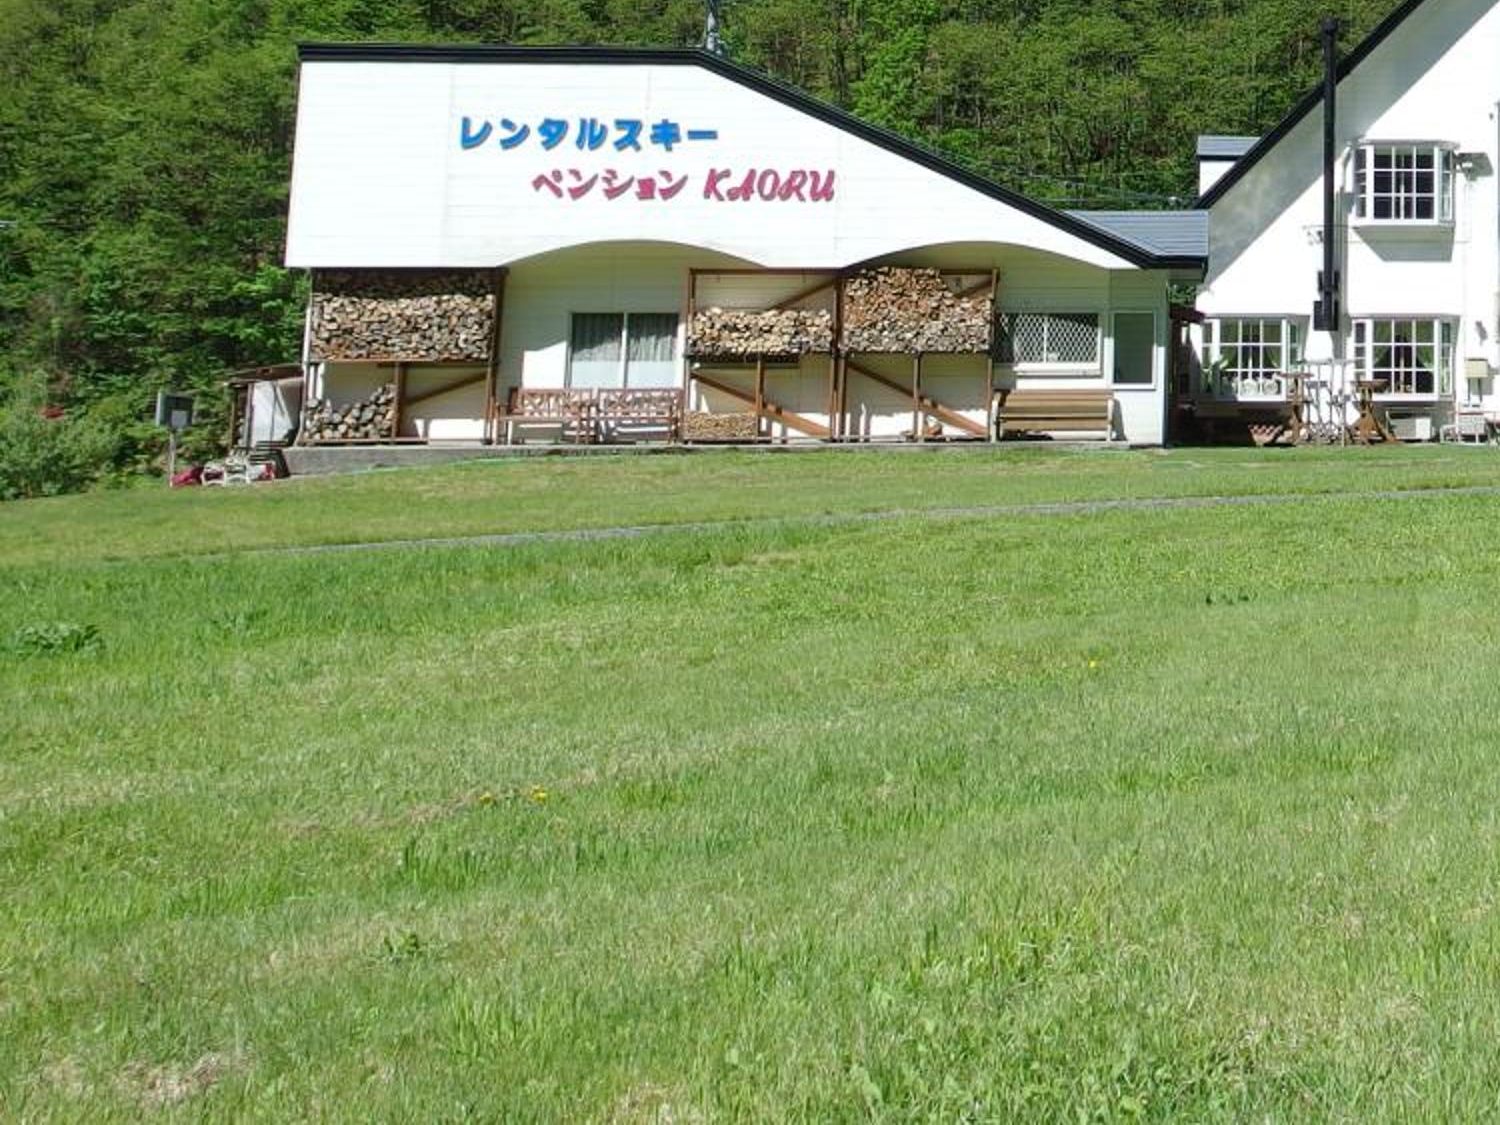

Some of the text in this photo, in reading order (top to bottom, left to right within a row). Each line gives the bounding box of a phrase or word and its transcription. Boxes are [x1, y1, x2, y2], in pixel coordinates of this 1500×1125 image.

[460, 116, 718, 151] レンタルスキー
[531, 168, 836, 202] ペンション KAORU
